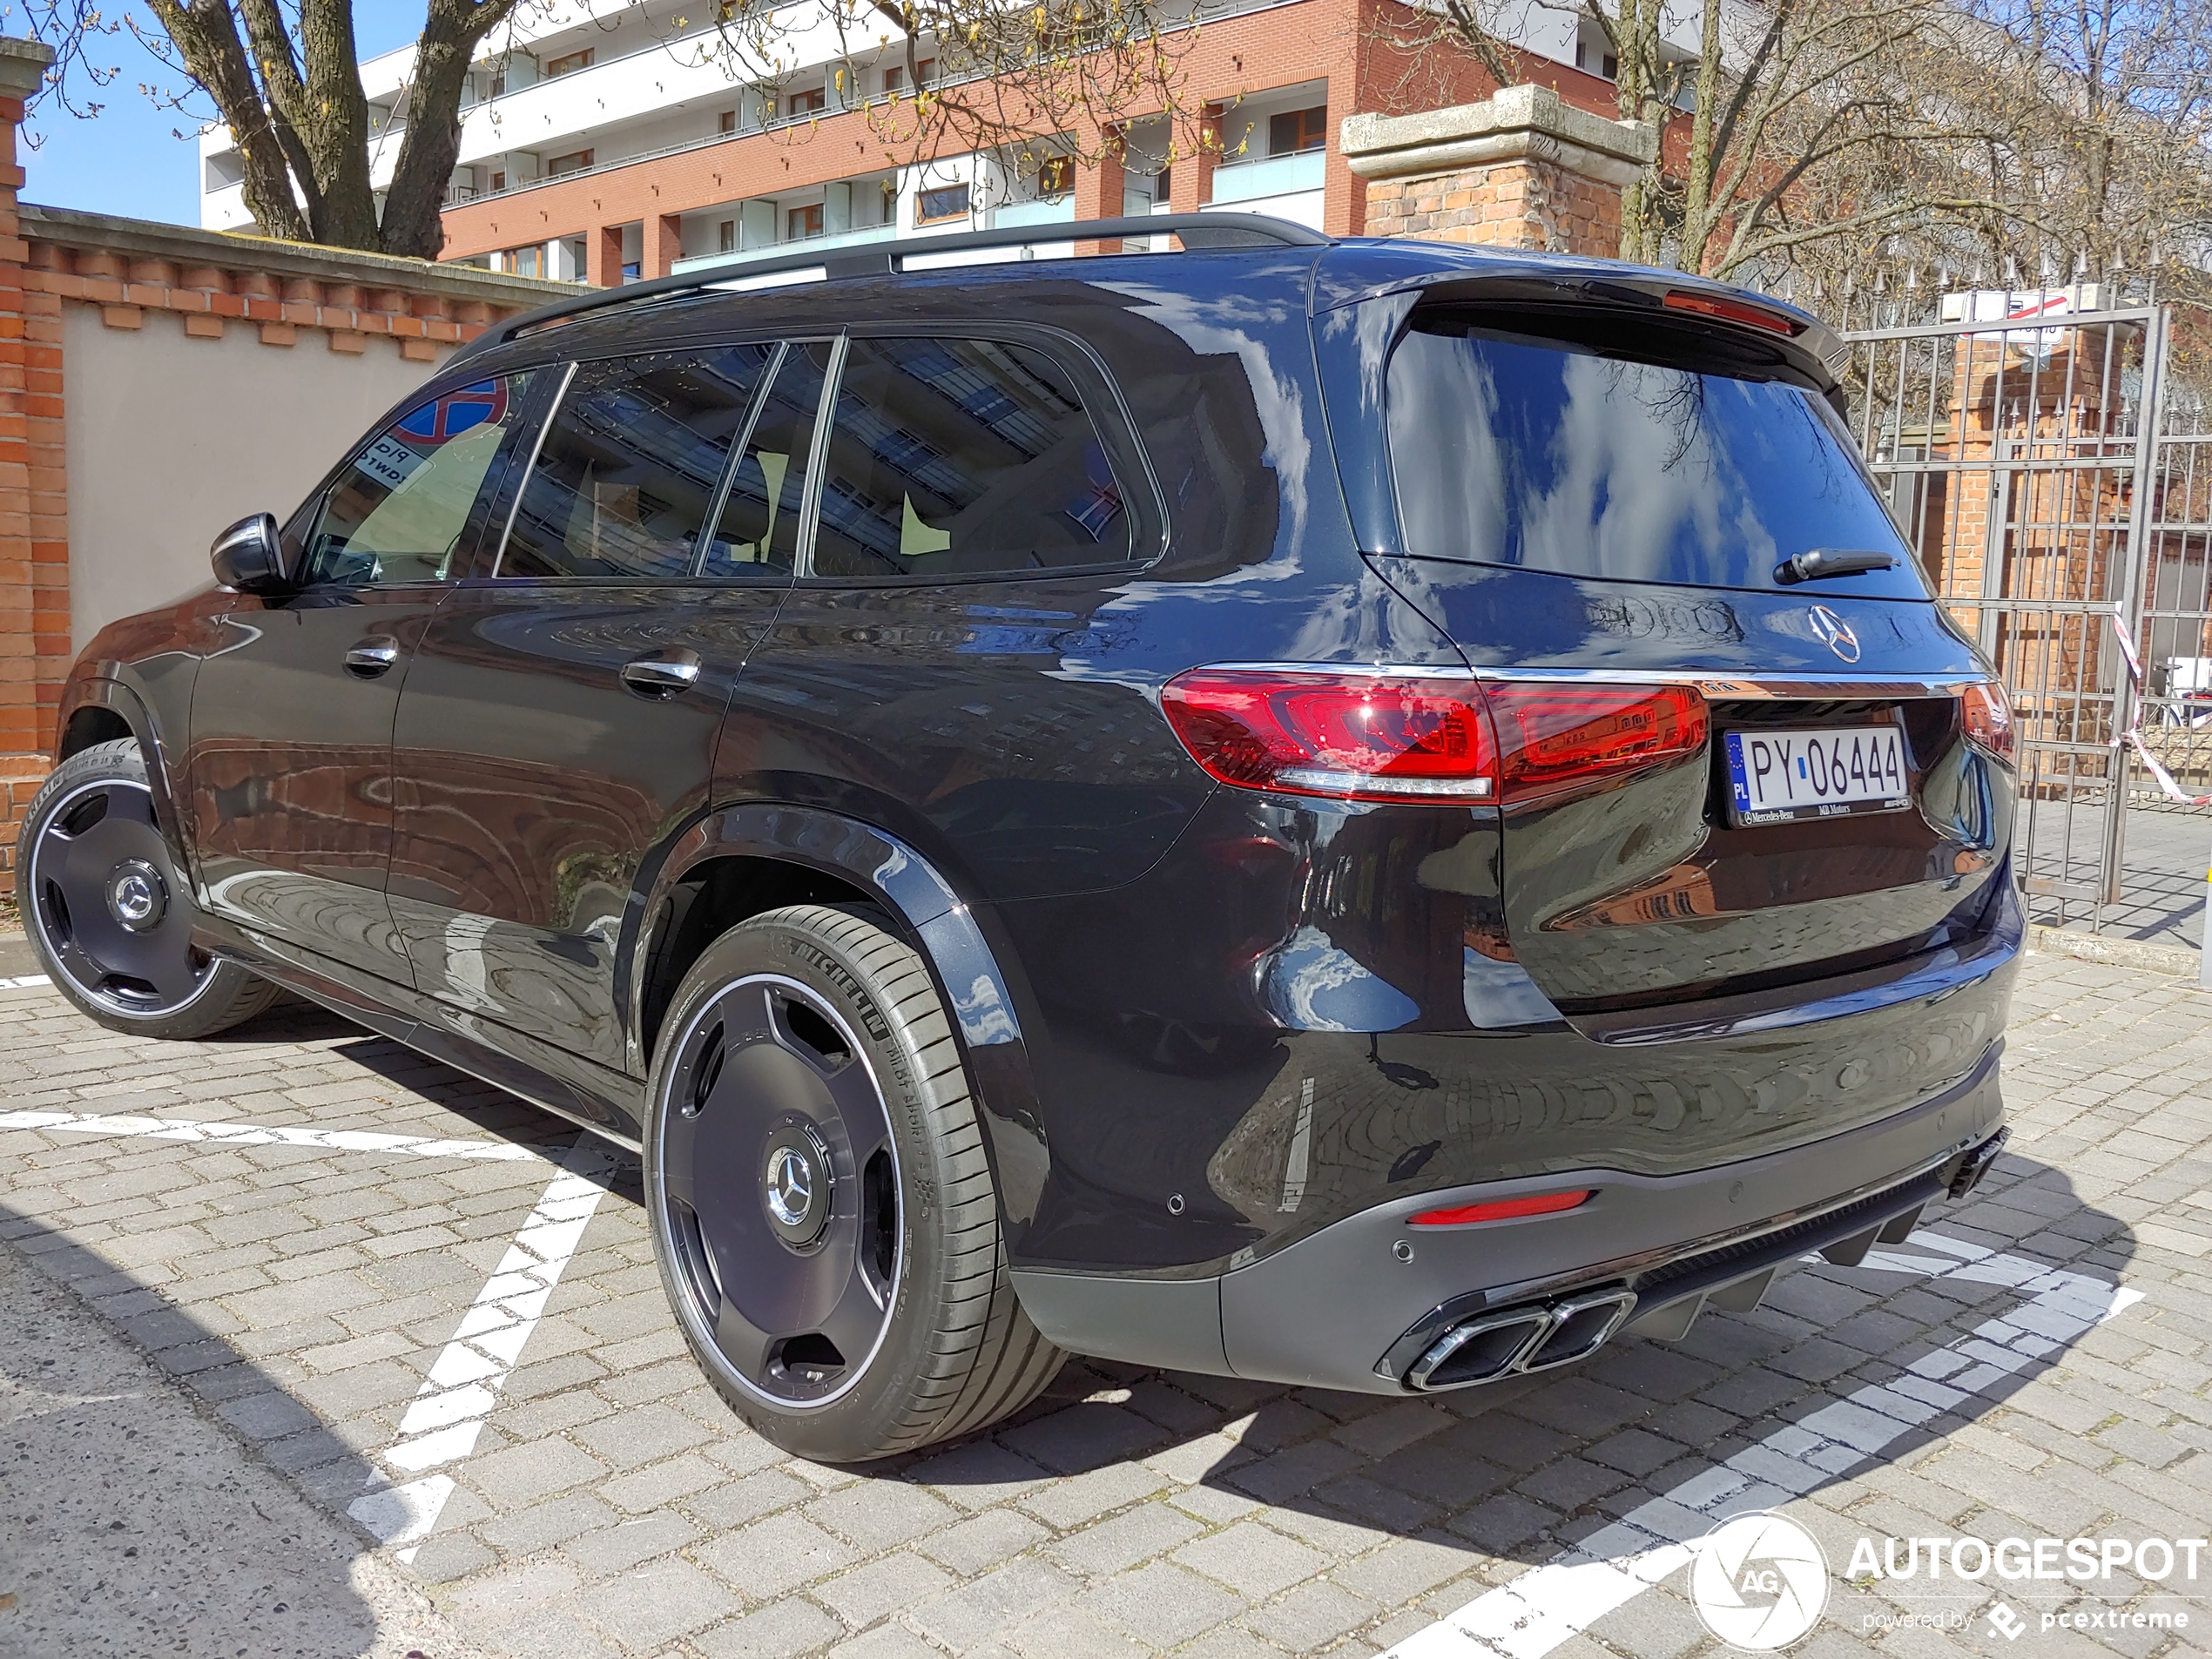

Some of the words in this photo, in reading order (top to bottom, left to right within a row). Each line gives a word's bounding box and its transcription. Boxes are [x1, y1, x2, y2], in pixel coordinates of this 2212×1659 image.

[1751, 739, 1794, 802] PY
[1807, 735, 1900, 797] 06444
[1733, 782, 1749, 800] PL
[1751, 809, 1795, 823] Mercedes-Benz
[1830, 804, 1851, 815] Motors
[794, 942, 887, 1035] MICHELIN
